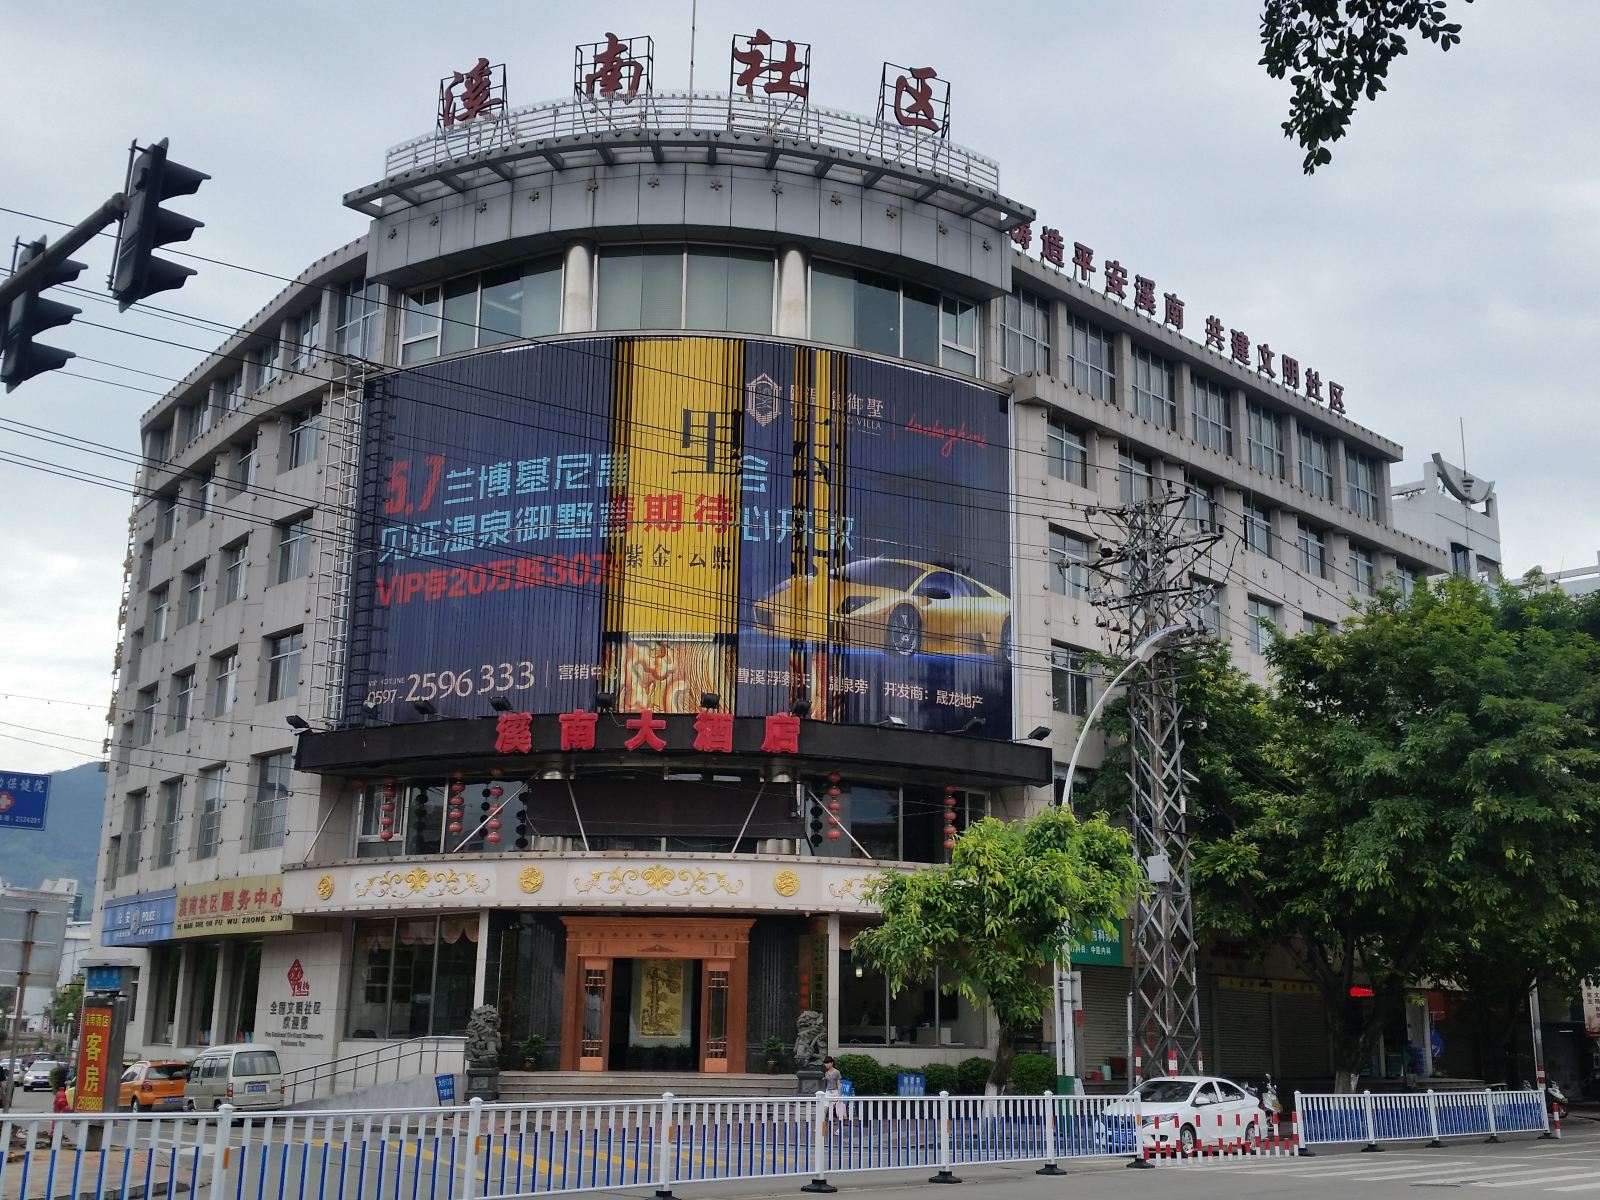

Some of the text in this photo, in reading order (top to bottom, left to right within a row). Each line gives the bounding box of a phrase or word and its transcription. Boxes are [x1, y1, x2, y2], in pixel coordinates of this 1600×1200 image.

[443, 28, 942, 132] 溪南社区
[1205, 314, 1347, 414] 共建文明社区
[495, 709, 800, 753] 溪南大酒店
[215, 918, 223, 926] FU
[242, 915, 265, 924] ZHONG
[270, 914, 283, 922] XIN
[270, 1001, 321, 1015] 全国文明社区
[84, 1033, 102, 1093] 客房
